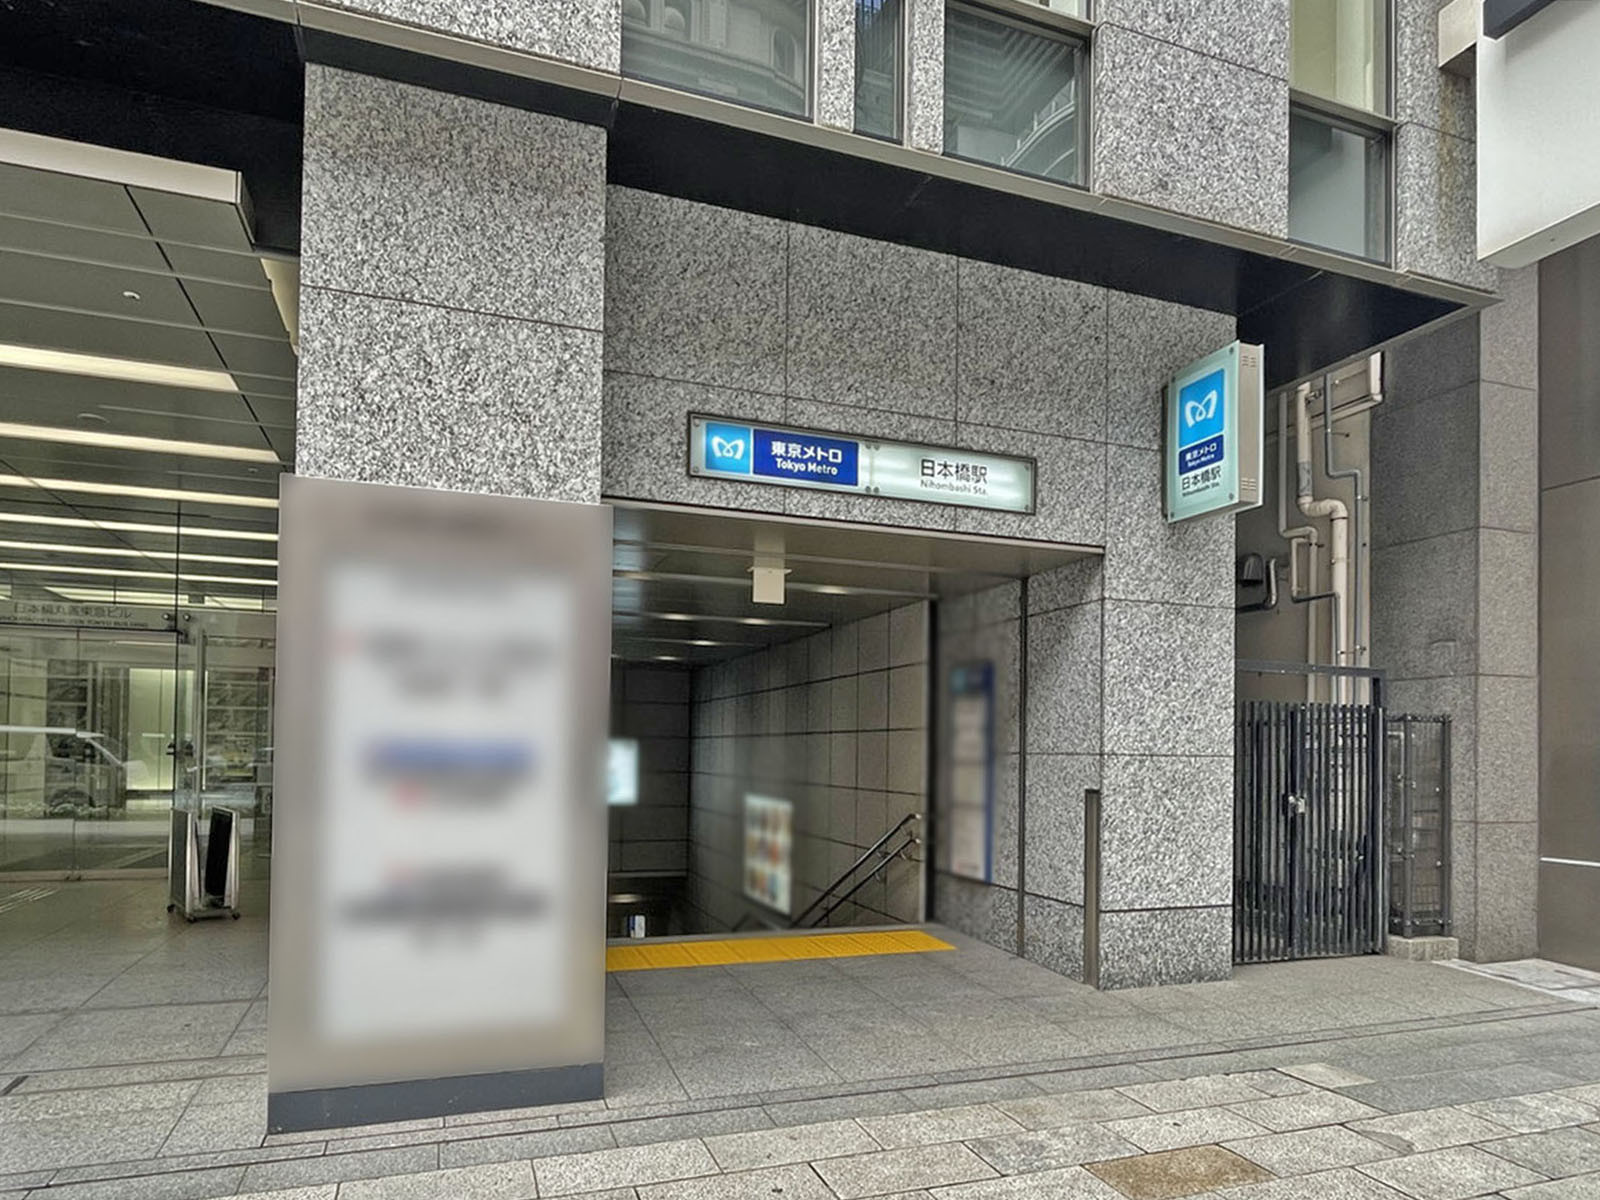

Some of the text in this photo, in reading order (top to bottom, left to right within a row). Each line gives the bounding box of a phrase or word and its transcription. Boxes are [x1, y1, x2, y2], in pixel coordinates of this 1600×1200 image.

[771, 441, 842, 463] 東京メトロ
[775, 458, 838, 475] Tokyo Metro
[921, 459, 988, 484] 日本橋駅
[1182, 465, 1221, 490] 日本橋駅
